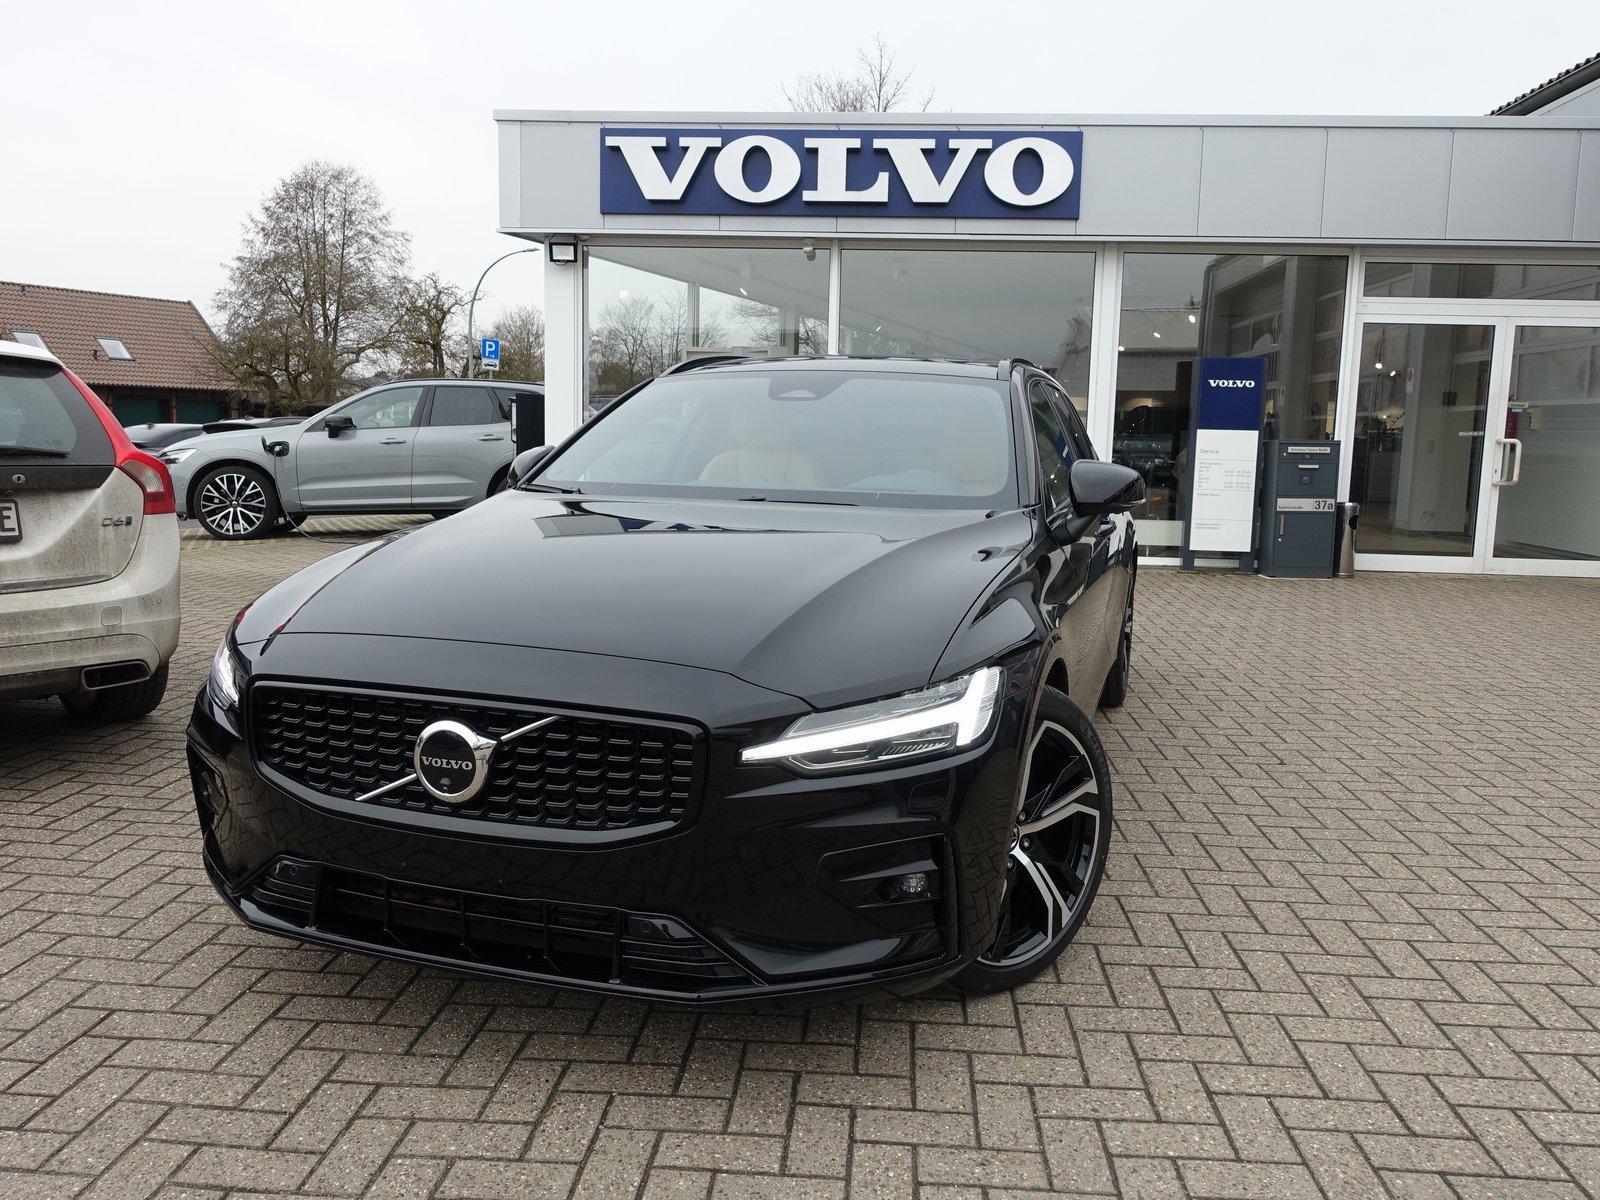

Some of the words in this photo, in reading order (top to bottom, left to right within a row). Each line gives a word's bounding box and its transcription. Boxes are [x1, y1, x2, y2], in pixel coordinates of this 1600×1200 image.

[605, 135, 1074, 207] VOLVO
[485, 341, 496, 357] P
[1208, 379, 1255, 388] VOLVO
[1314, 500, 1334, 510] 37a
[421, 755, 473, 771] VOLVO
